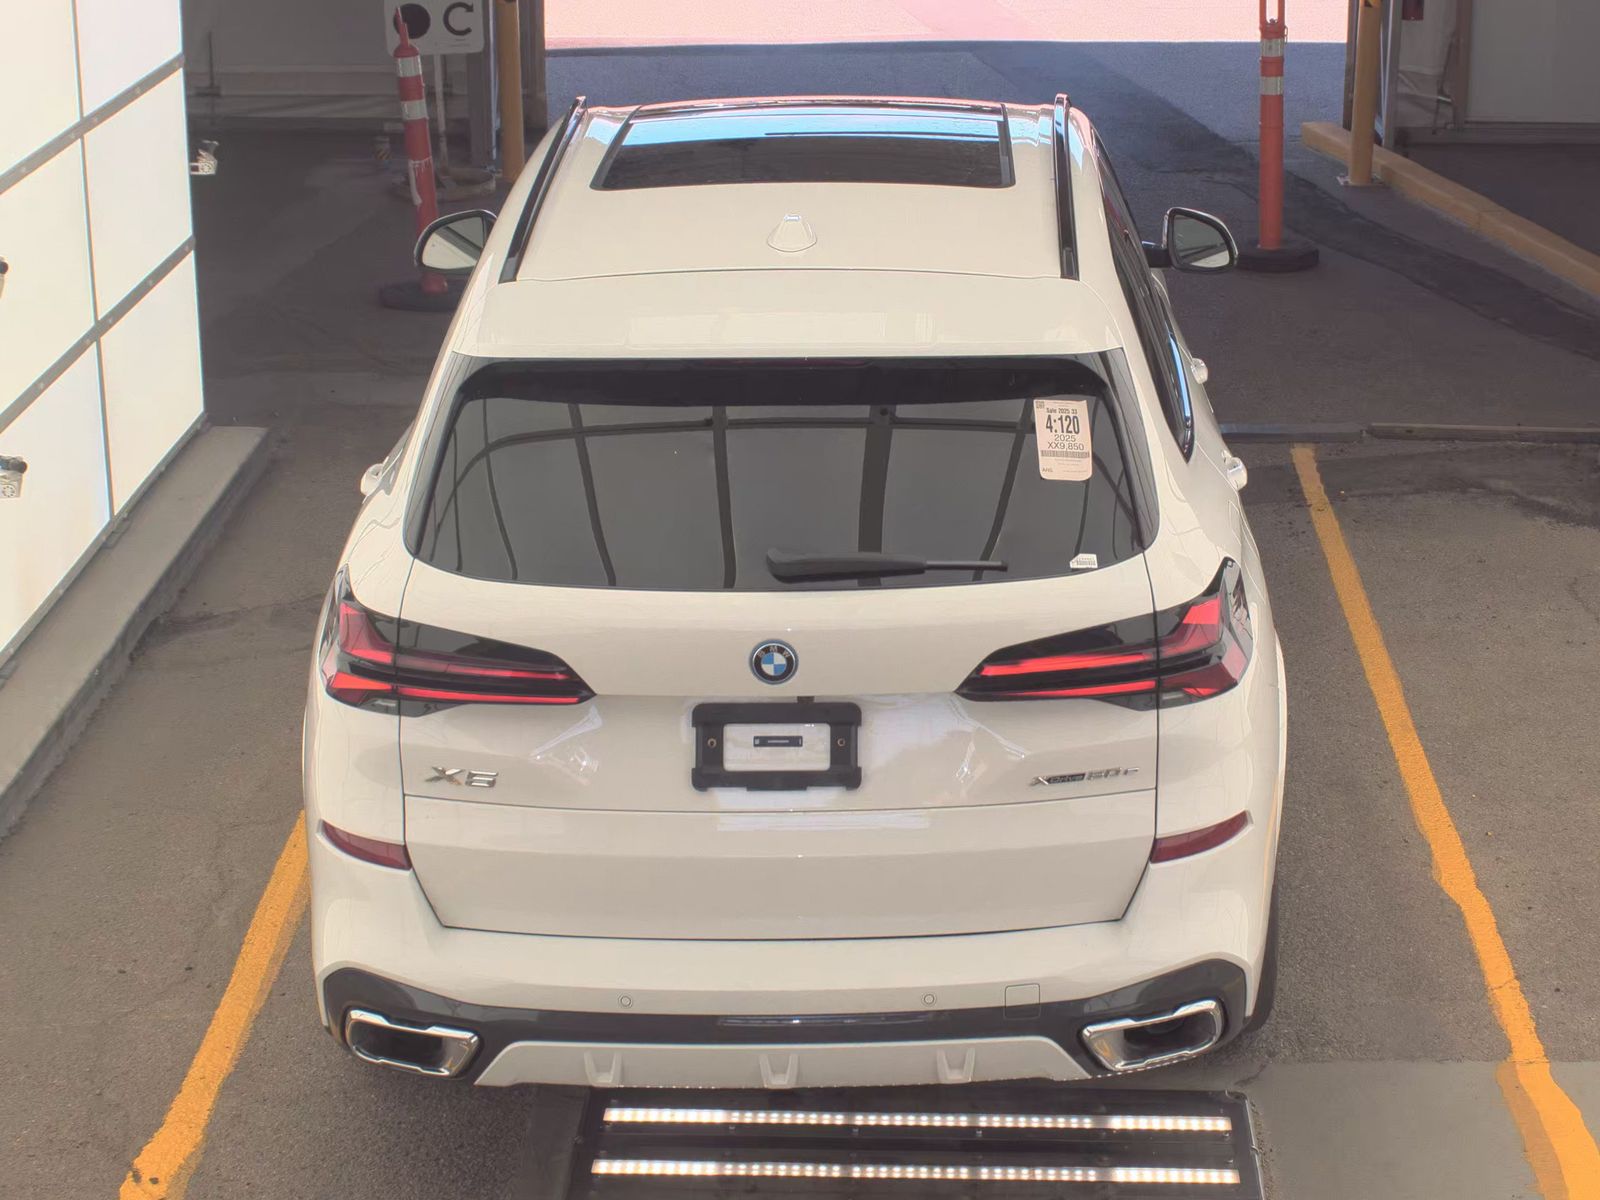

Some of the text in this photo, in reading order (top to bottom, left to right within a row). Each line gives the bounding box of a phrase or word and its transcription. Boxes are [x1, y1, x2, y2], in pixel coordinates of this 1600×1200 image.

[1046, 414, 1080, 434] 4:120
[1054, 434, 1077, 442] 2025
[1047, 441, 1085, 451] XX9,850
[424, 766, 499, 788] X5
